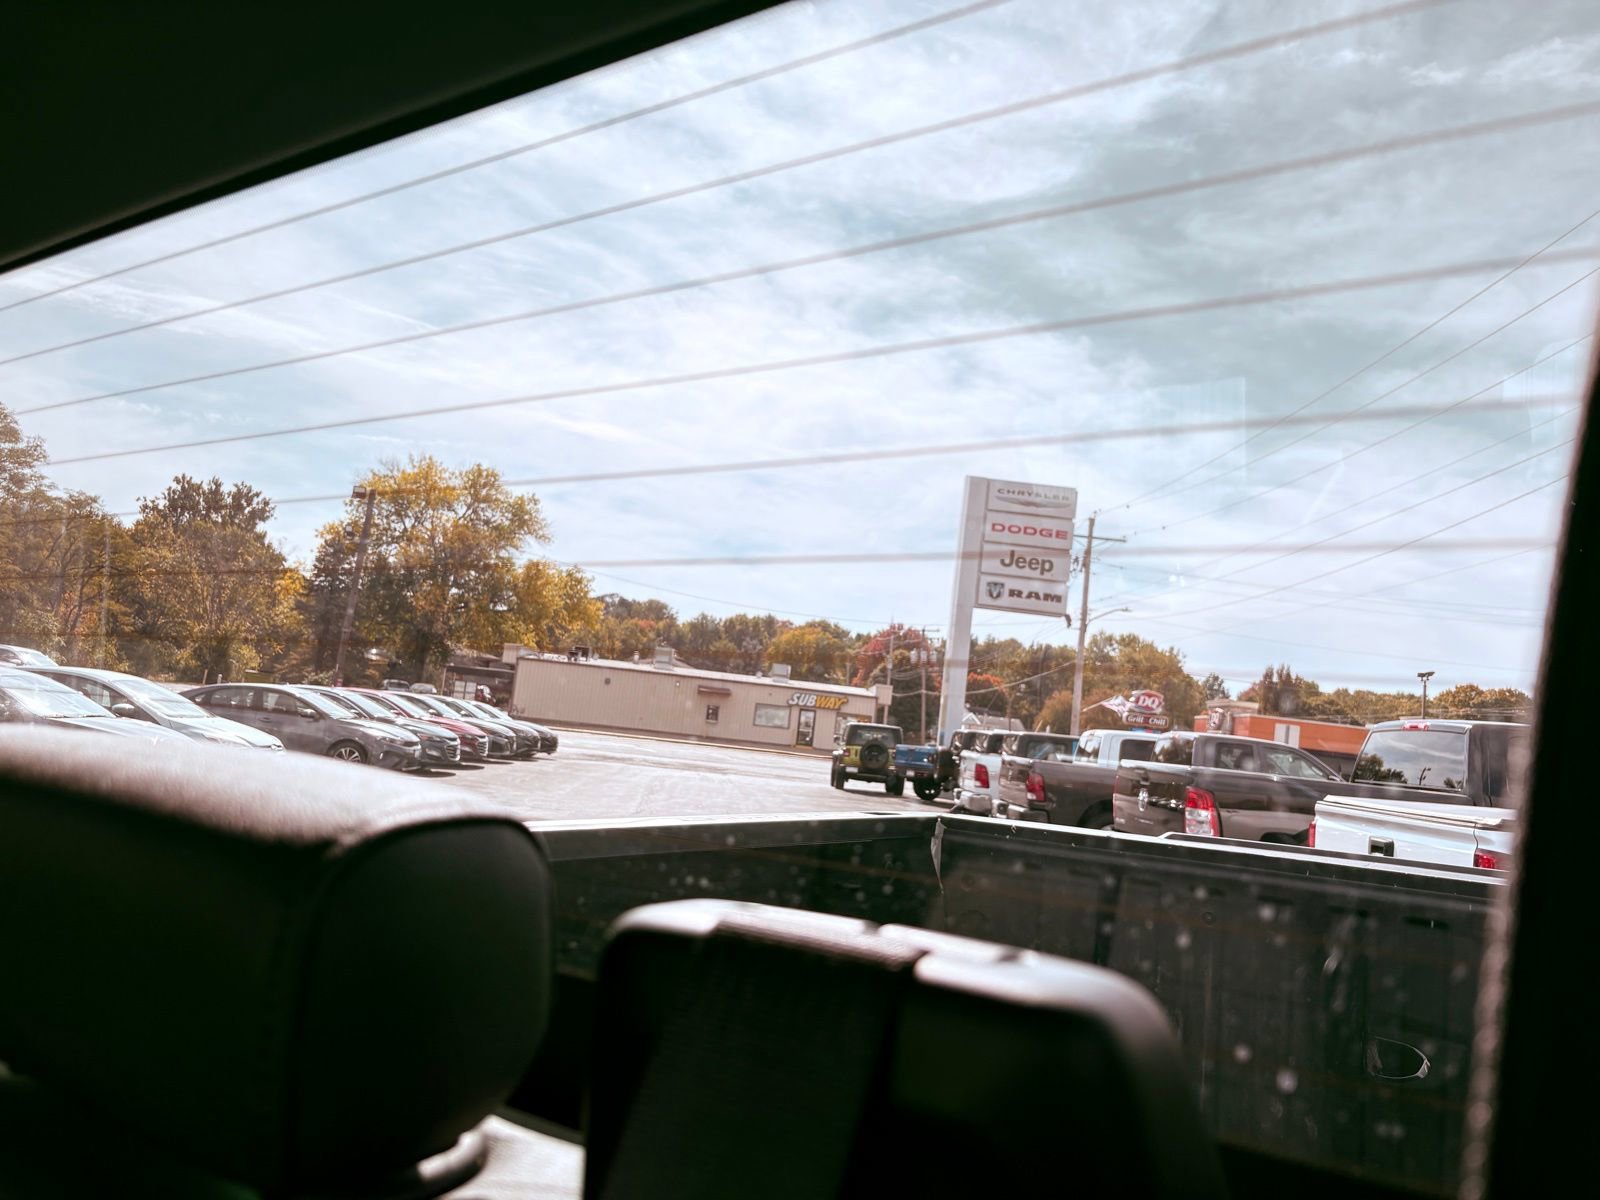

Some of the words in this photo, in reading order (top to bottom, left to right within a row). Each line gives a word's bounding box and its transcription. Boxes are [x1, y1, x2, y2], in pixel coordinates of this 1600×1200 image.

[991, 523, 1069, 540] DODGE
[1000, 550, 1054, 575] Jeep
[1008, 588, 1063, 603] RAM
[788, 693, 848, 709] SUBWAY
[1138, 695, 1159, 709] DQ
[1128, 714, 1144, 724] Grill
[1149, 716, 1166, 726] Chill
